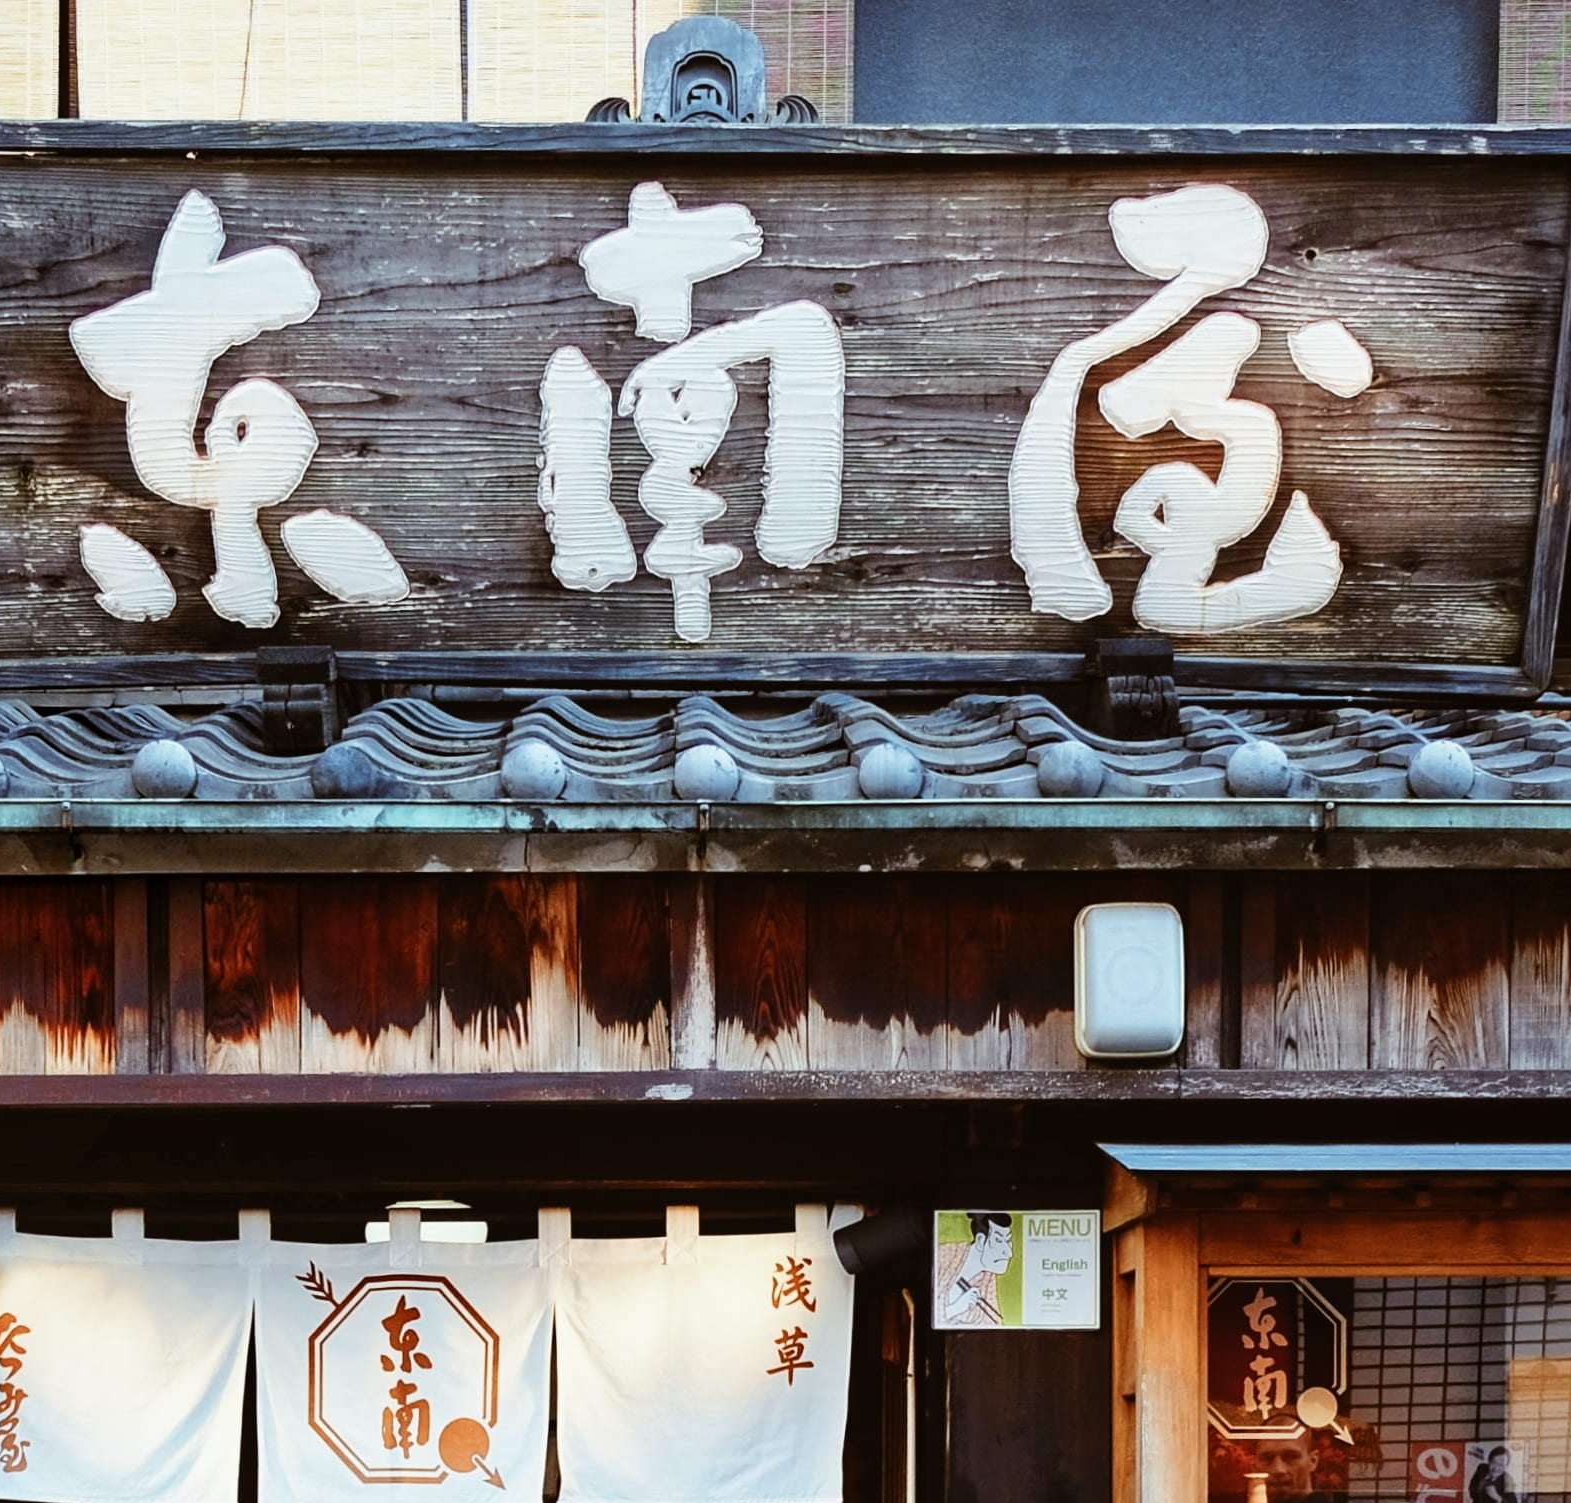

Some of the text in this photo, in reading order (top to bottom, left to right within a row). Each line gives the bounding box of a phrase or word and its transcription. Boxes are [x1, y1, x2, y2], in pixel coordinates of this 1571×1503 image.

[1028, 1218, 1091, 1237] MENU
[1042, 1258, 1088, 1271] English
[1042, 1288, 1068, 1300] 中文
[765, 1255, 819, 1388] 浅草
